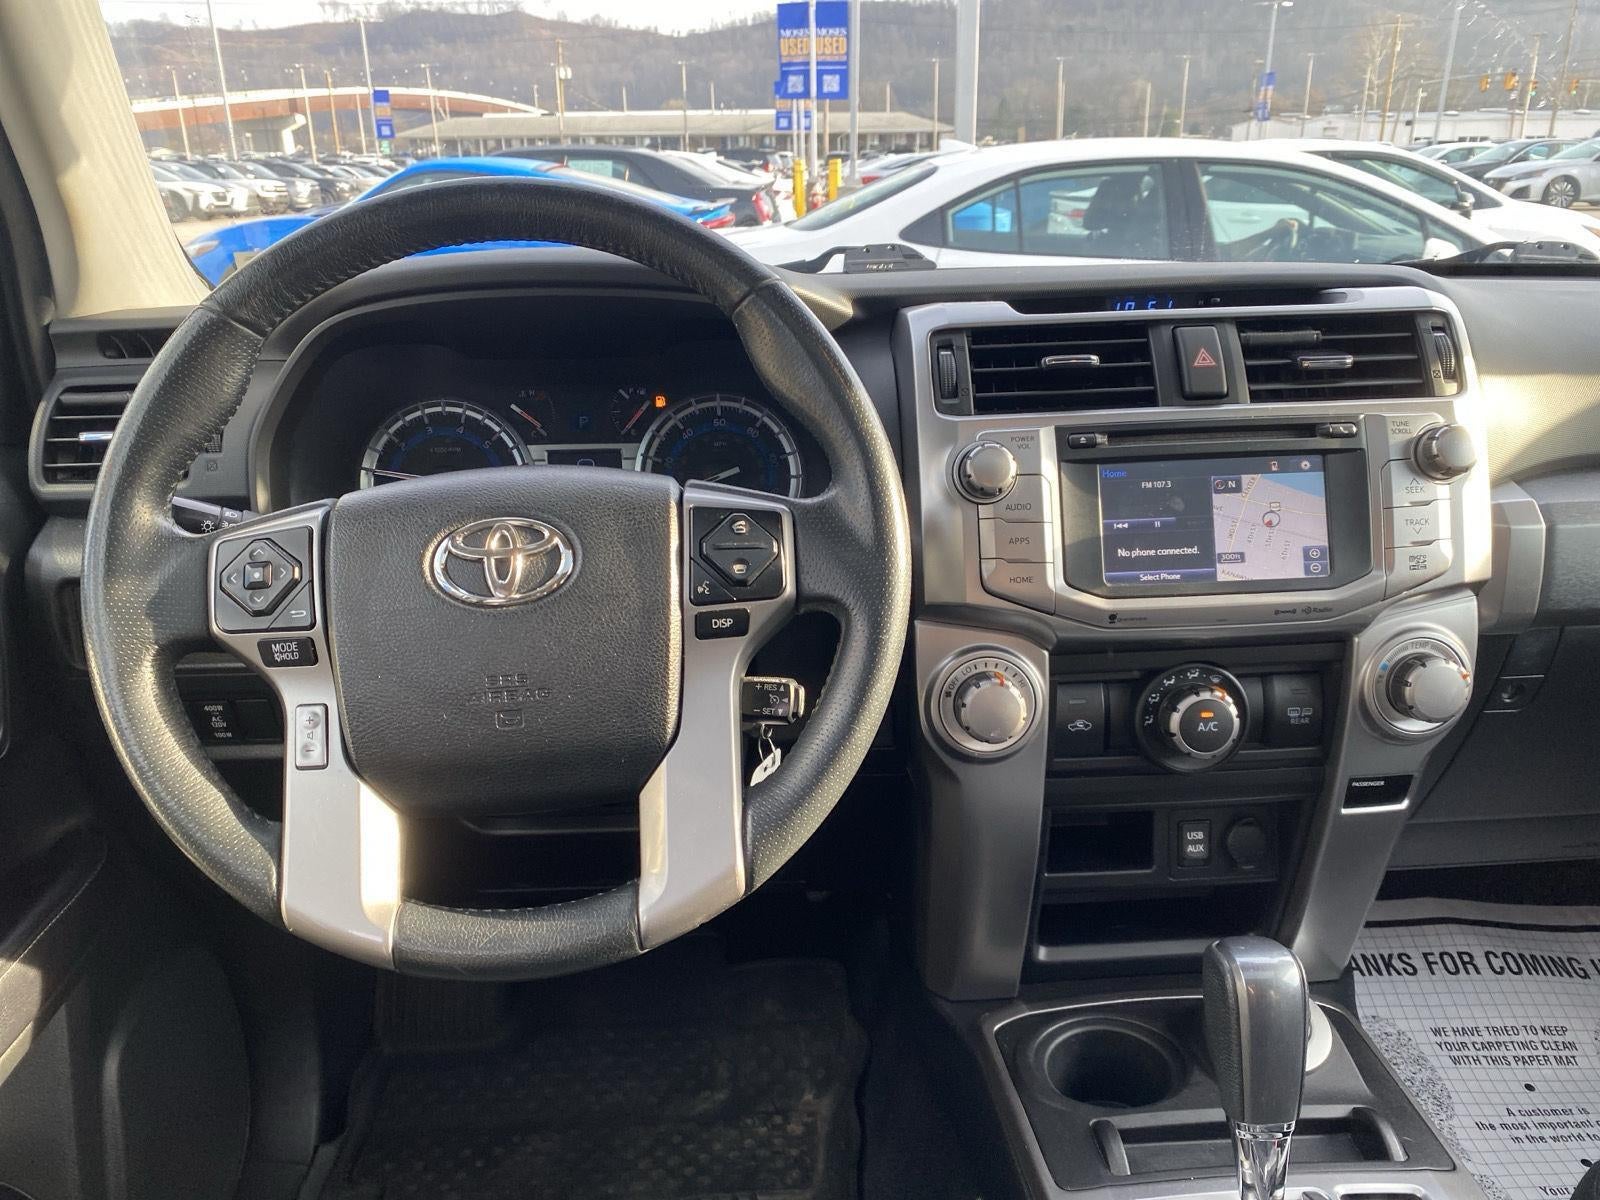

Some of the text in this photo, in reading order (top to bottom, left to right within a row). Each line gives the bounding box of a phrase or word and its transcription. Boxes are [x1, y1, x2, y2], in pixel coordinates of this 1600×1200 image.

[816, 36, 847, 55] USED
[426, 426, 433, 435] 3
[456, 425, 464, 434] 4
[682, 428, 695, 440] 40
[482, 440, 492, 449] 5
[1102, 470, 1127, 478] Home
[1153, 480, 1172, 488] 107.3
[1228, 481, 1236, 489] N
[1405, 486, 1425, 494] SEEK
[1005, 502, 1032, 511] AUDIO
[1405, 518, 1430, 526] TRACK
[1008, 537, 1031, 545] APPS
[1117, 546, 1200, 558] No phone connected.
[1009, 576, 1035, 584] HOME
[711, 619, 734, 629] DISP
[271, 641, 299, 653] MODE
[1411, 641, 1430, 649] TEMP
[279, 652, 299, 661] HOLD
[961, 666, 972, 676] LO
[763, 683, 778, 691] RES
[948, 676, 959, 691] OFF
[762, 707, 776, 716] SET
[1290, 717, 1310, 725] REAR
[1197, 721, 1219, 732] A/C
[1187, 831, 1204, 840] USB
[1187, 844, 1205, 853] AUX
[1423, 951, 1481, 976] FOR
[1485, 950, 1591, 980] COMING
[1429, 1025, 1568, 1037] WE HAVE TRIED TO KEEP
[1435, 1040, 1579, 1052] YOUR CARPETING CLEAN
[1448, 1055, 1579, 1066] WITH THIS PAPER MAT
[1506, 1106, 1591, 1117] A customer is
[1475, 1121, 1497, 1131] the
[1499, 1121, 1531, 1131] most
[1510, 1132, 1600, 1144] in the world to
[1538, 1185, 1571, 1196] Your
